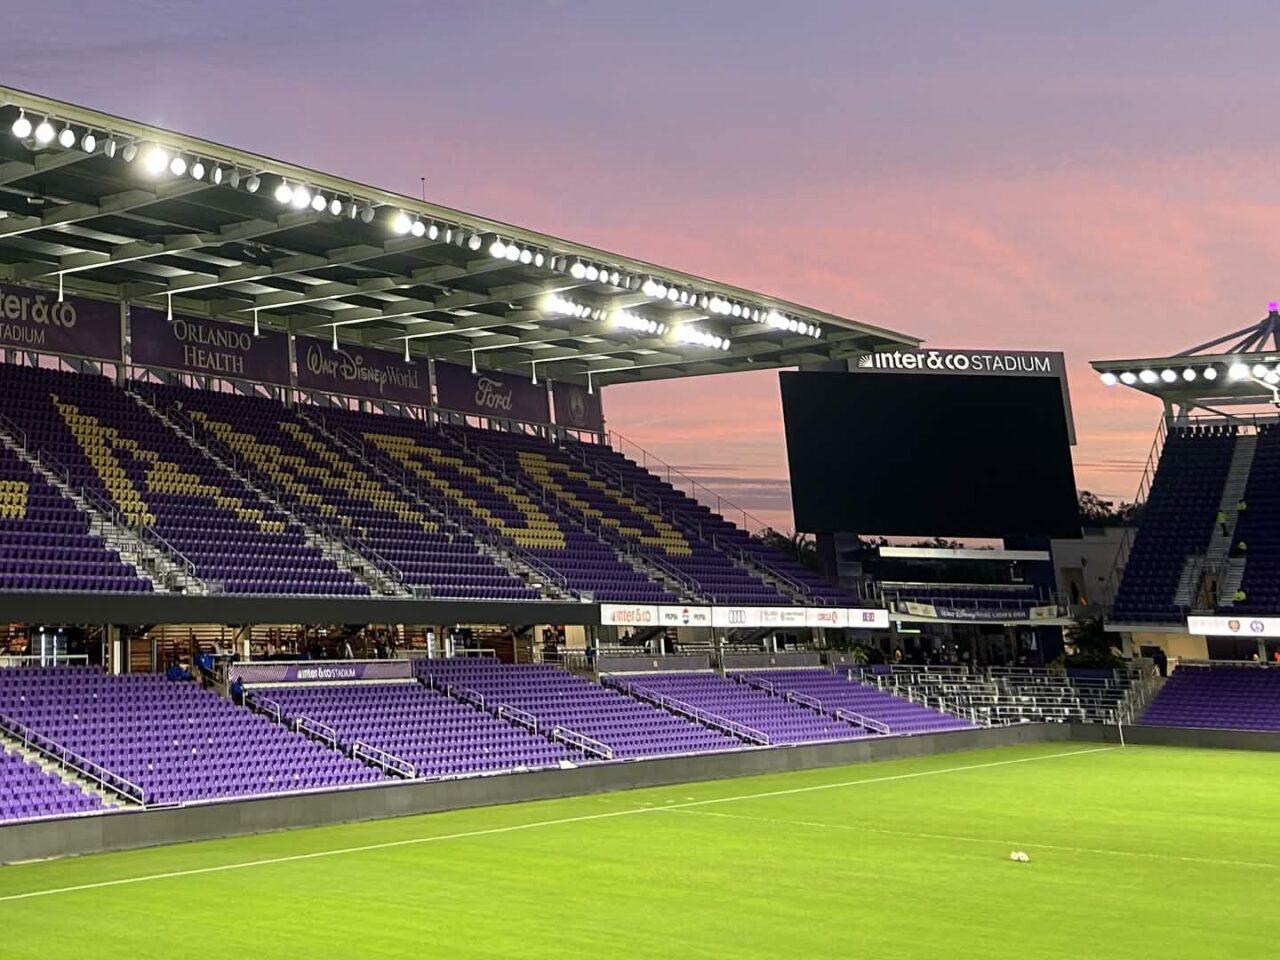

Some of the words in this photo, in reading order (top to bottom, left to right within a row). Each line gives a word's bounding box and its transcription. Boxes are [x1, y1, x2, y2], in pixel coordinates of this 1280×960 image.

[173, 319, 252, 351] ORLANDO
[183, 344, 245, 374] HEALTH
[971, 354, 1051, 372] STADIUM
[386, 365, 419, 389] World
[474, 376, 513, 411] Ford
